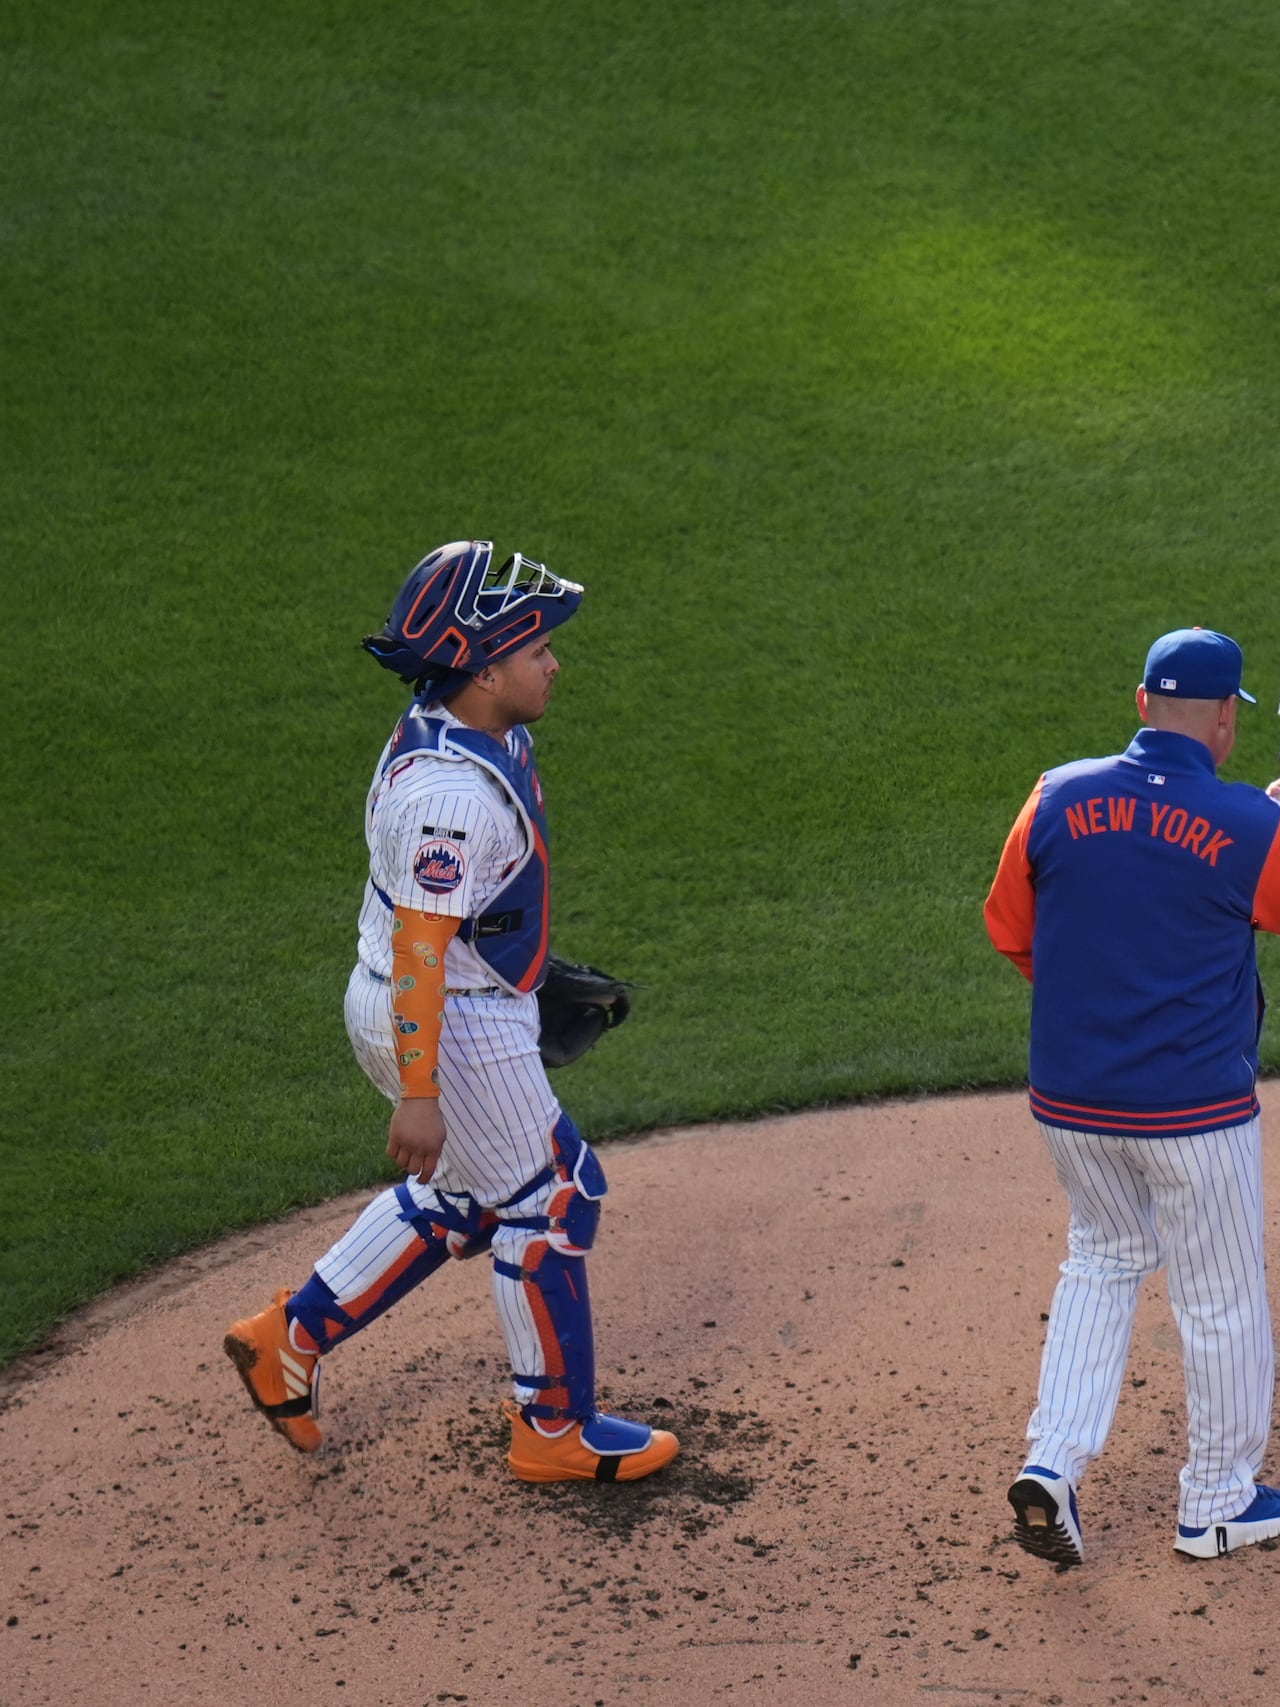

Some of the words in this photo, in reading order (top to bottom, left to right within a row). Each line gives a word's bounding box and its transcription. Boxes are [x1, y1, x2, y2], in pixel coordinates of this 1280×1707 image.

[1065, 797, 1137, 840] NEW
[1151, 802, 1234, 867] YORK
[421, 860, 457, 880] Mets
